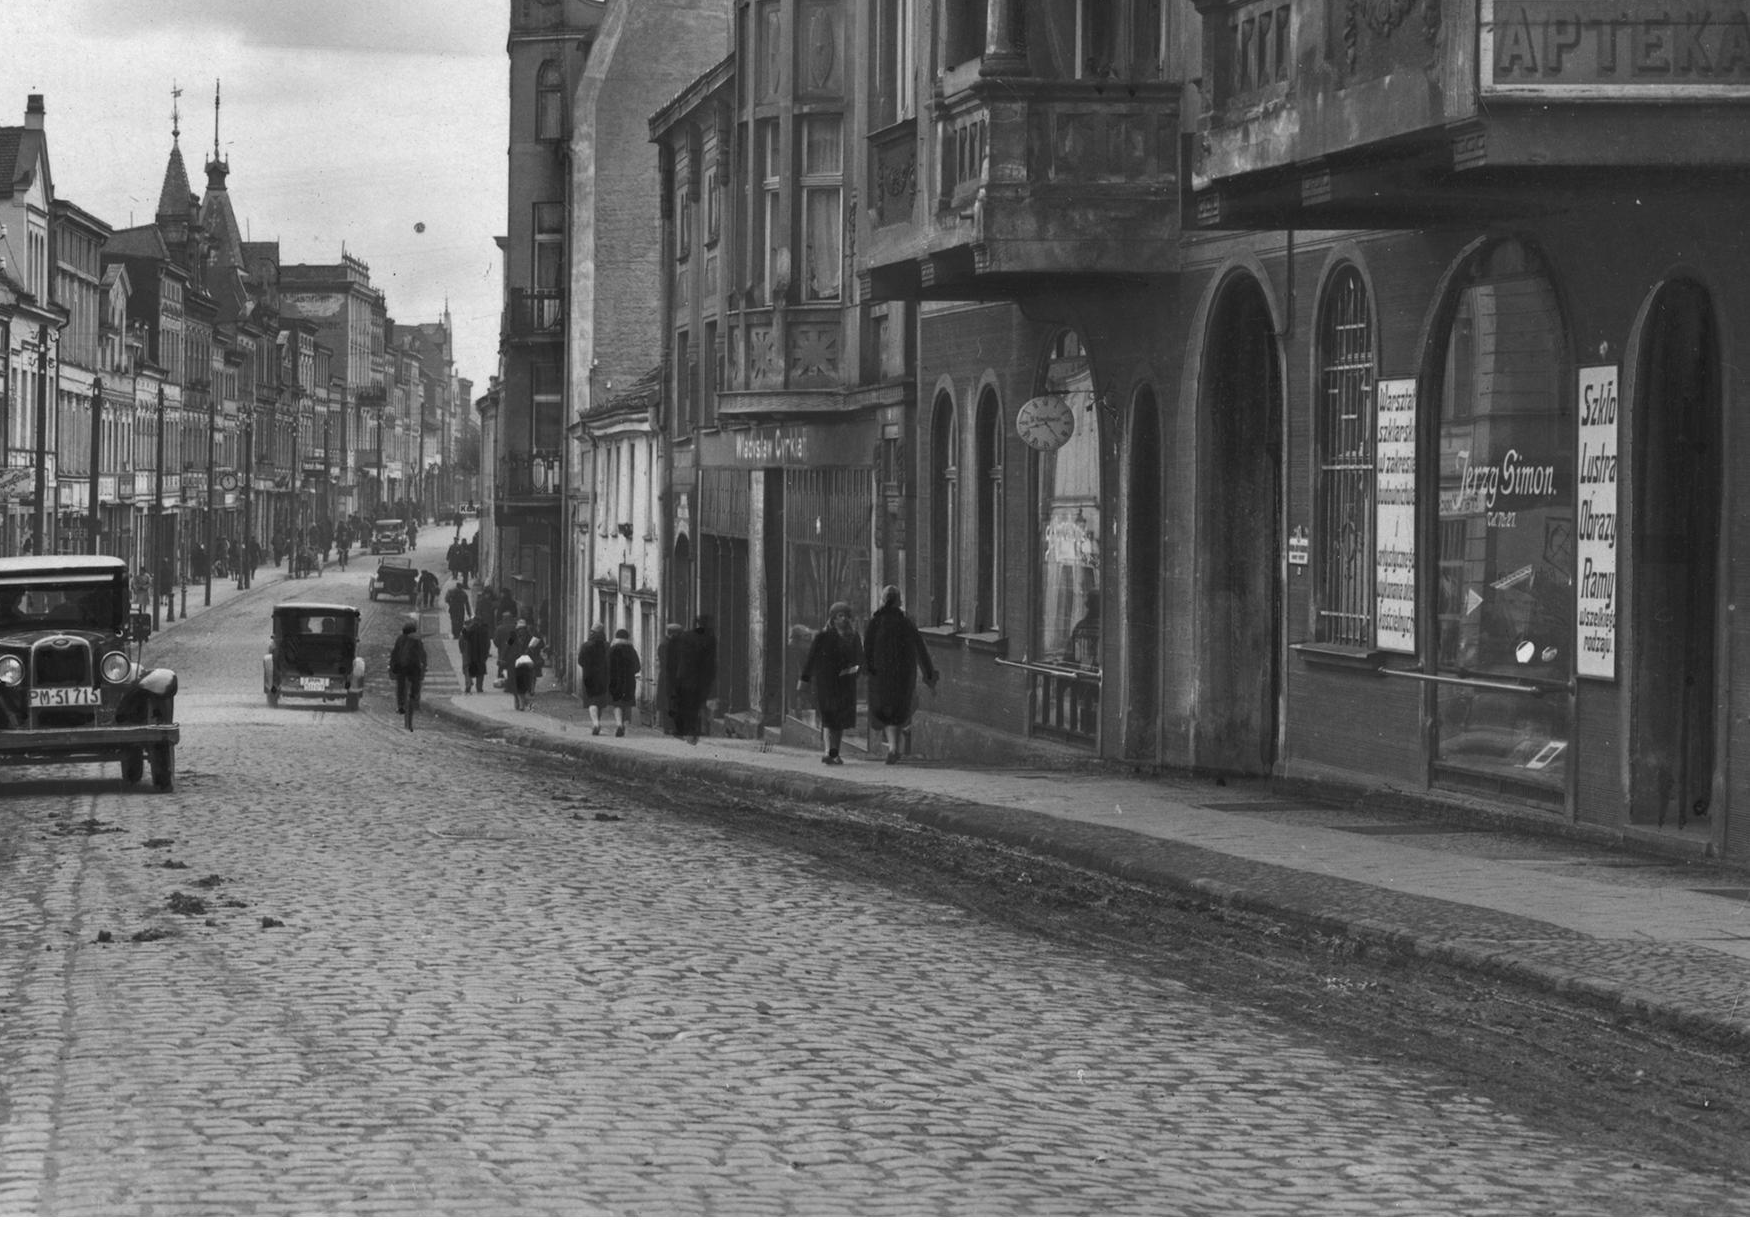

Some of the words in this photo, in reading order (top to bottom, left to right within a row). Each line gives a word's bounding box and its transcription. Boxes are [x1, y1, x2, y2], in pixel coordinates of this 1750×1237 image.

[1498, 5, 1750, 76] APTEKA
[1452, 450, 1499, 508] Jerzy
[1501, 449, 1557, 495] Simon.
[1580, 442, 1617, 484] Lustra
[1579, 499, 1616, 549] Obrazy
[1581, 557, 1615, 609] Ramy
